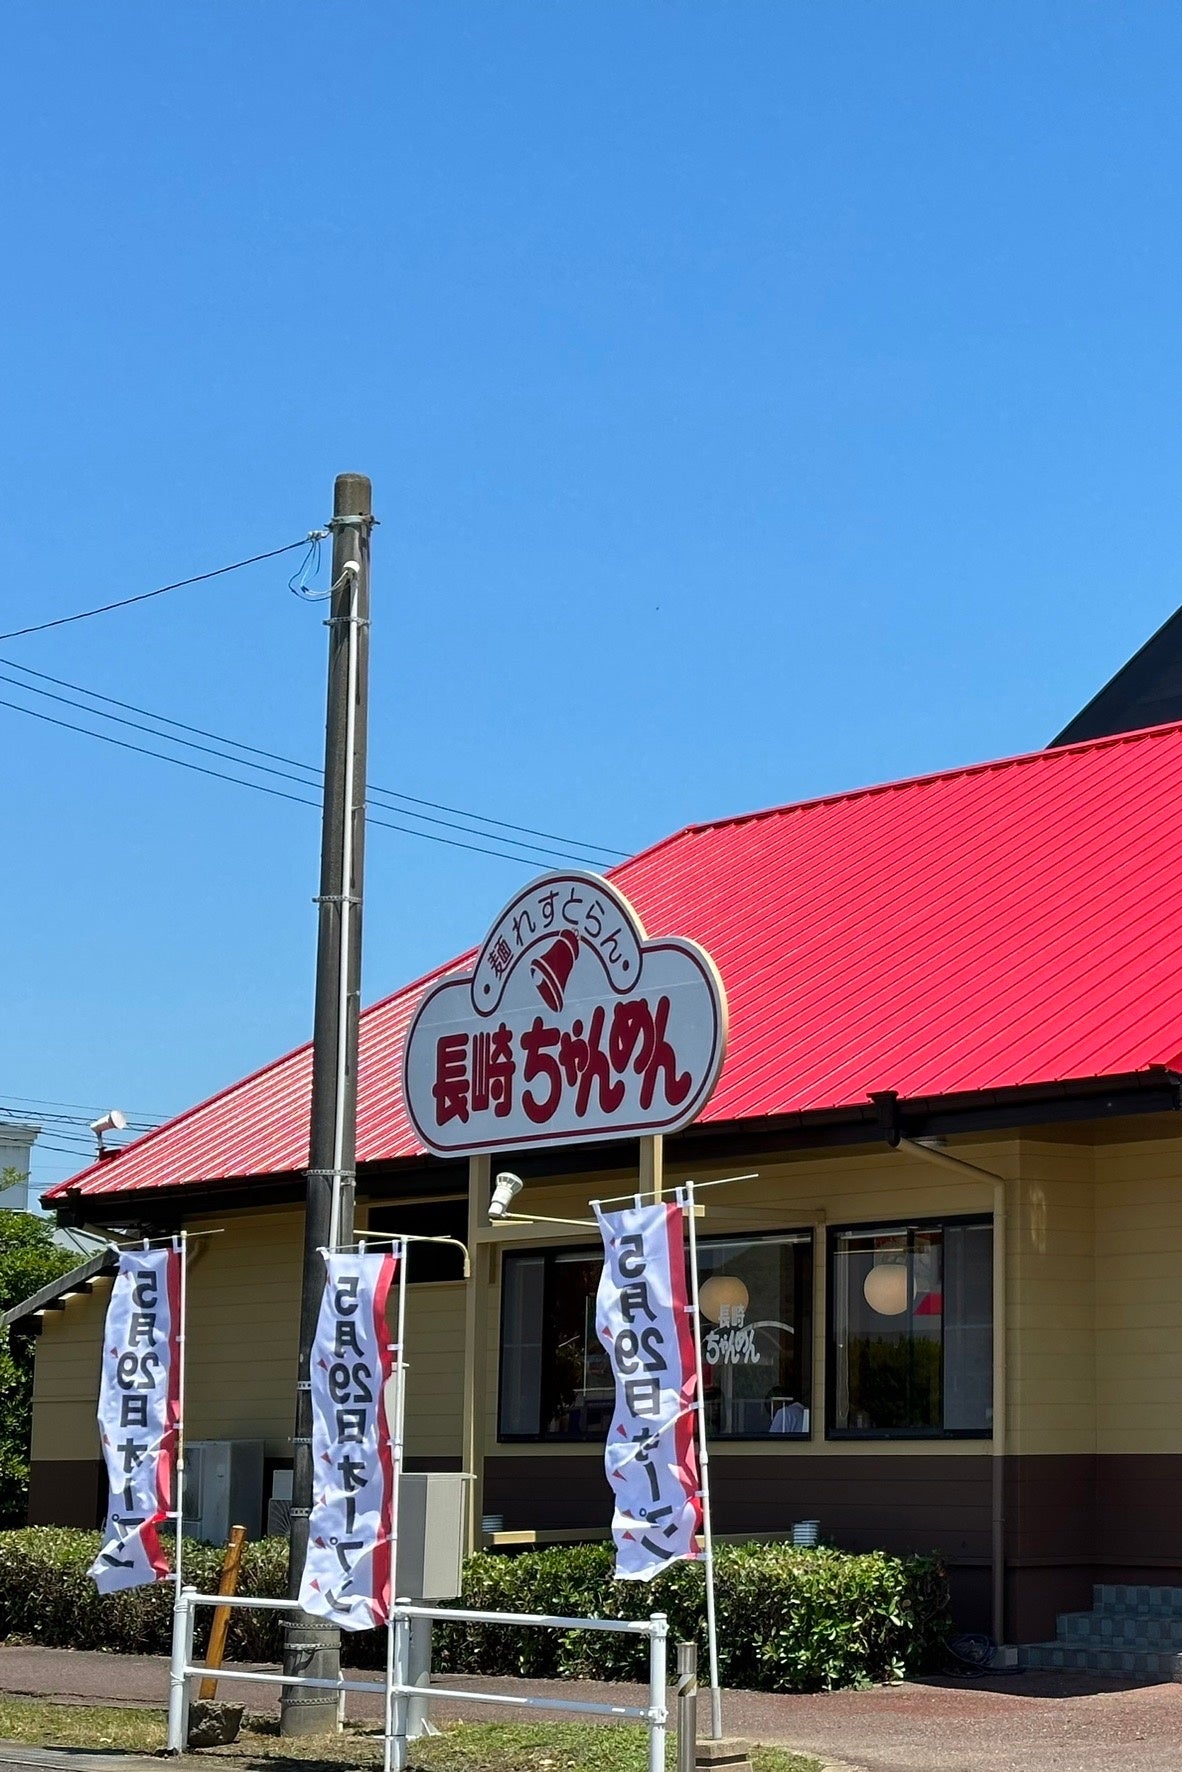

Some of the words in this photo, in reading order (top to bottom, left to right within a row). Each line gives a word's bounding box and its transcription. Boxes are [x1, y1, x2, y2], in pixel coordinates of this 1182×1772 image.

[432, 996, 693, 1127] 長崎ちゃんめん
[717, 1304, 746, 1328] 長崎
[706, 1328, 761, 1365] ちゃんめん
